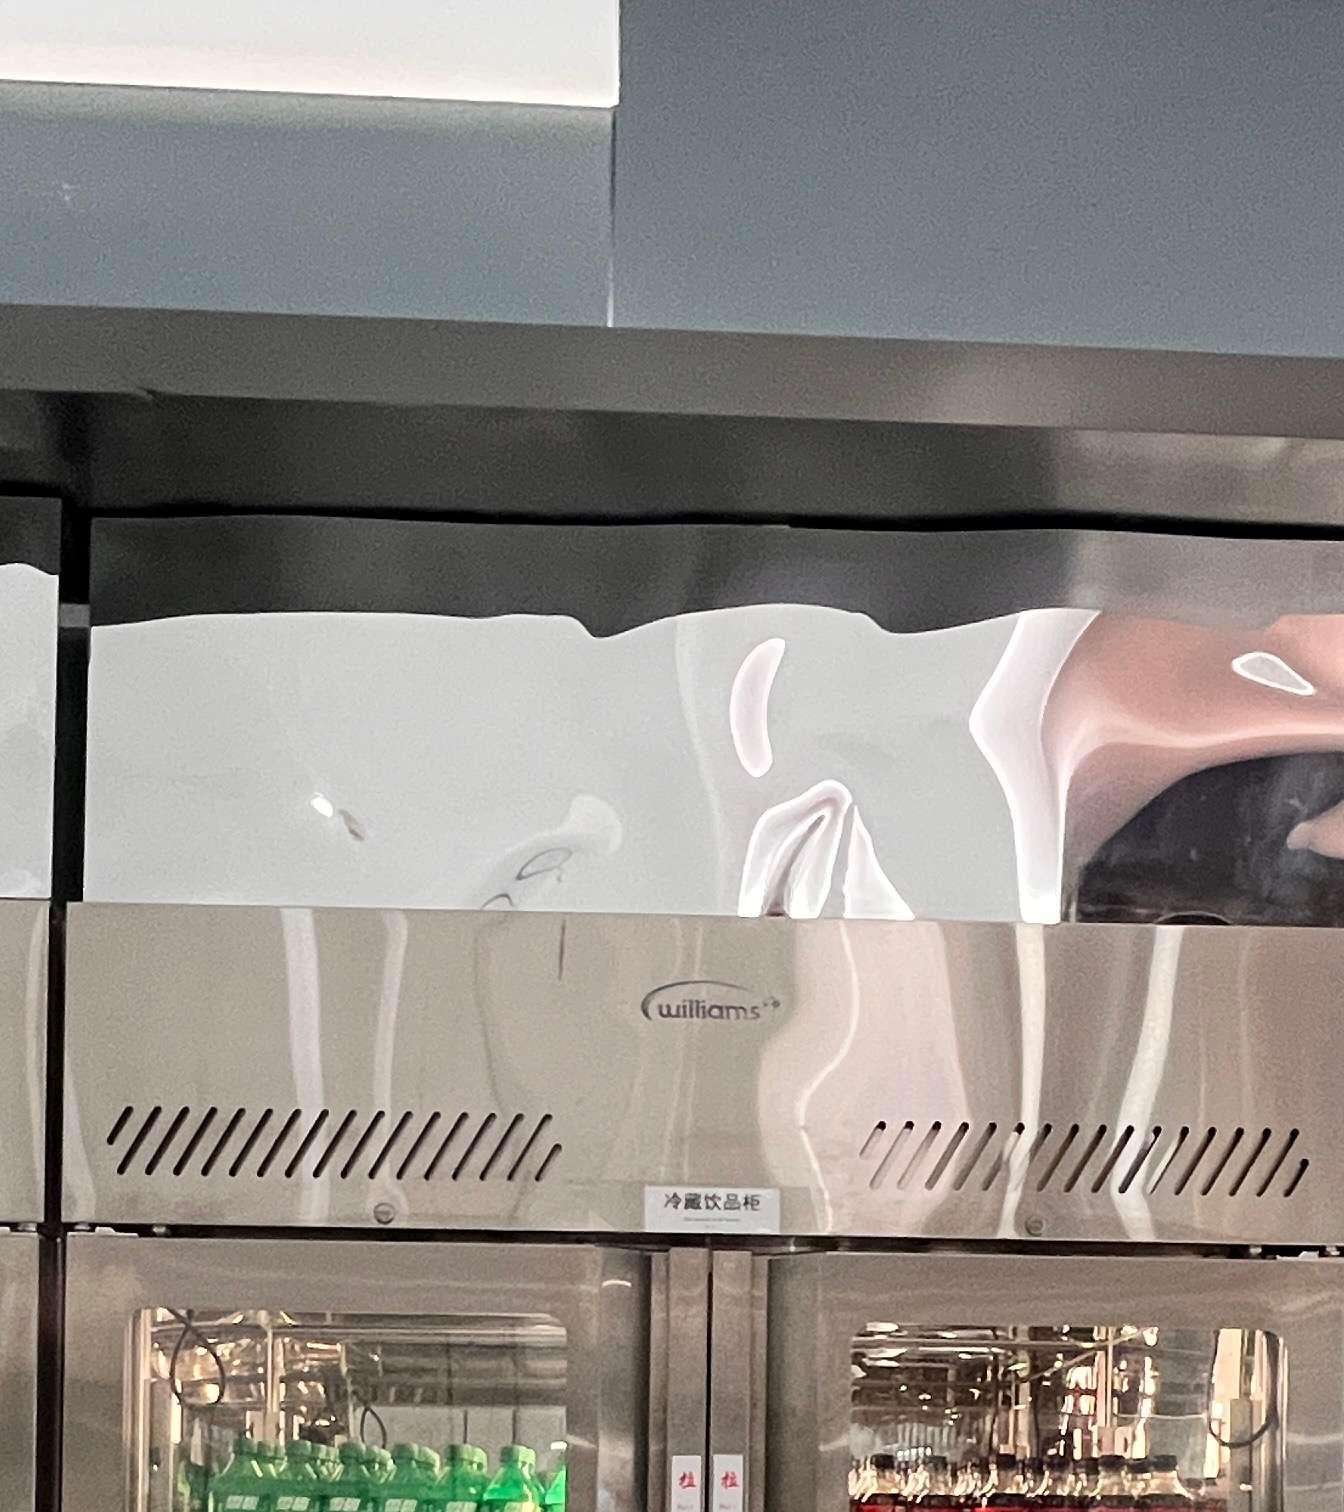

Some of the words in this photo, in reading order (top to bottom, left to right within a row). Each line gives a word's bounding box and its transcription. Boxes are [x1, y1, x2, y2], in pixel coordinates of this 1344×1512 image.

[657, 998, 761, 1021] williams
[664, 1191, 762, 1211] 冷藏饮品柜
